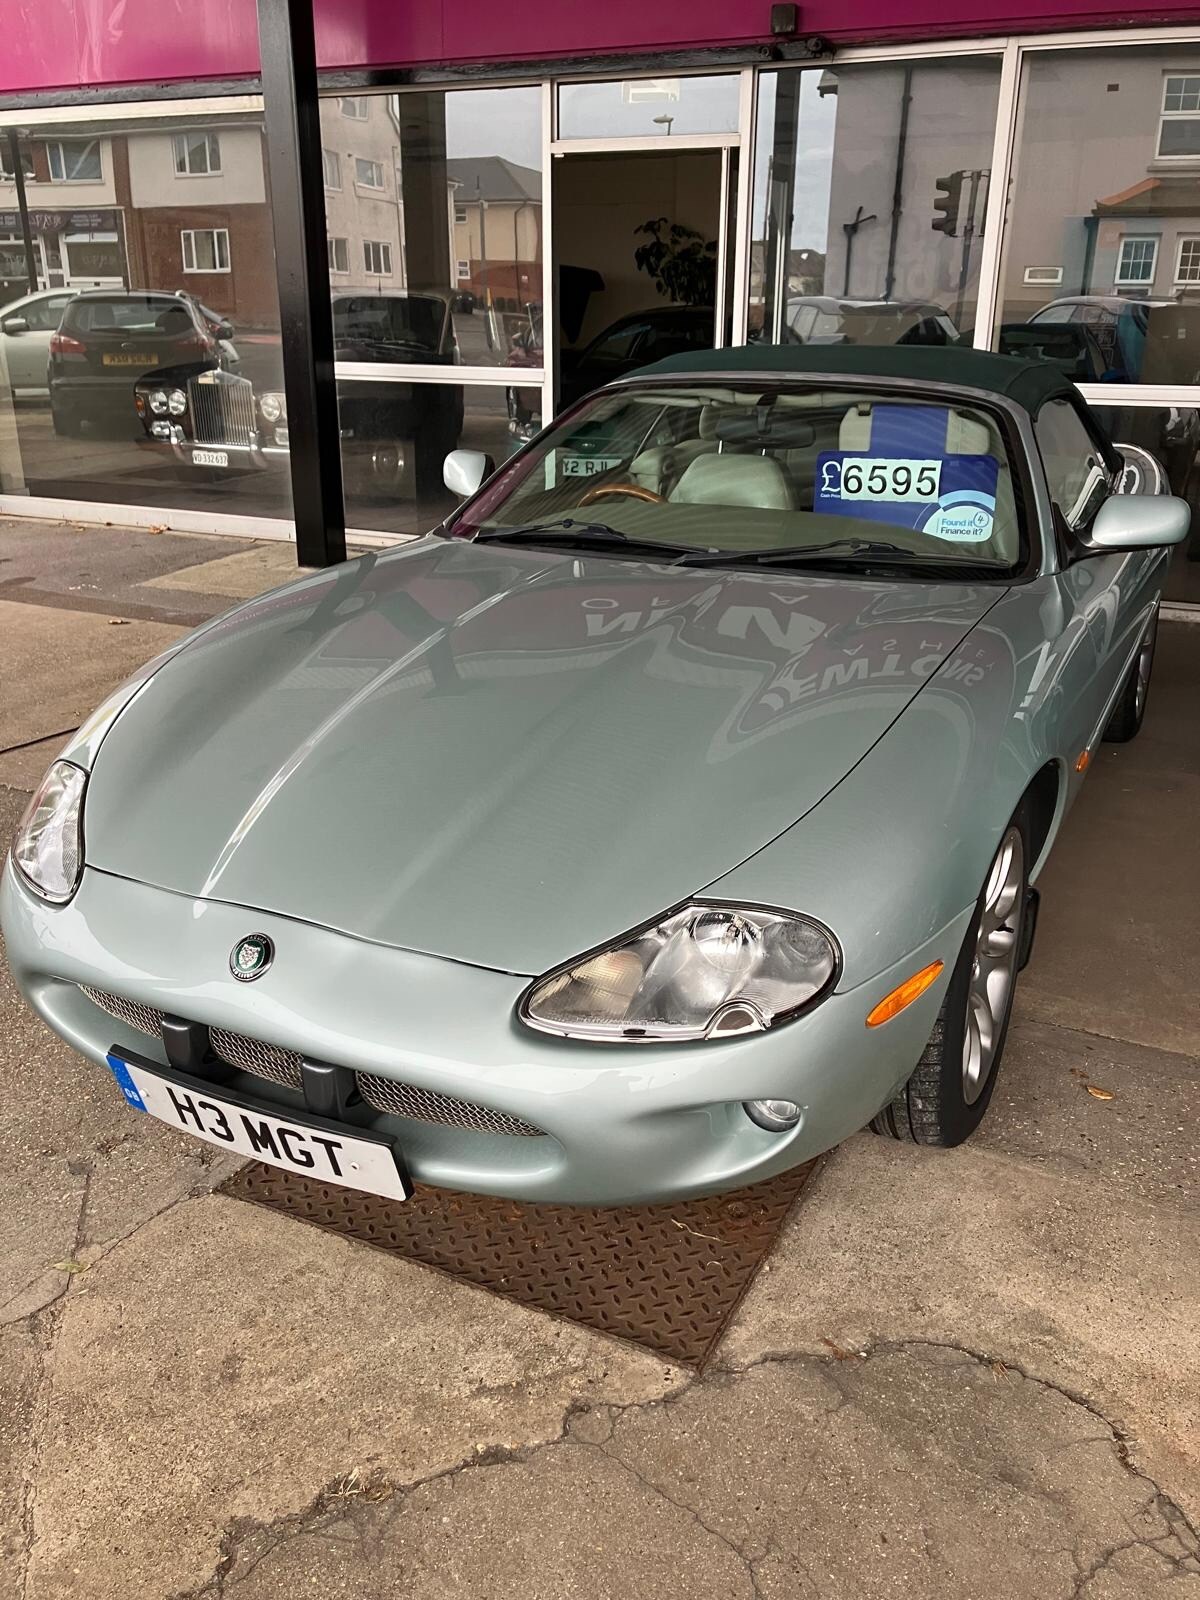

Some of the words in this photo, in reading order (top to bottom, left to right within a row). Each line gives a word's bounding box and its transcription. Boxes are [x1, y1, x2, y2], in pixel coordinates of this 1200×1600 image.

[821, 461, 937, 496] £6595
[941, 518, 967, 527] Found
[940, 526, 971, 535] Finance
[972, 528, 984, 536] it?
[125, 1087, 140, 1102] GB
[165, 1086, 235, 1143] H3
[240, 1114, 343, 1177] MGT
